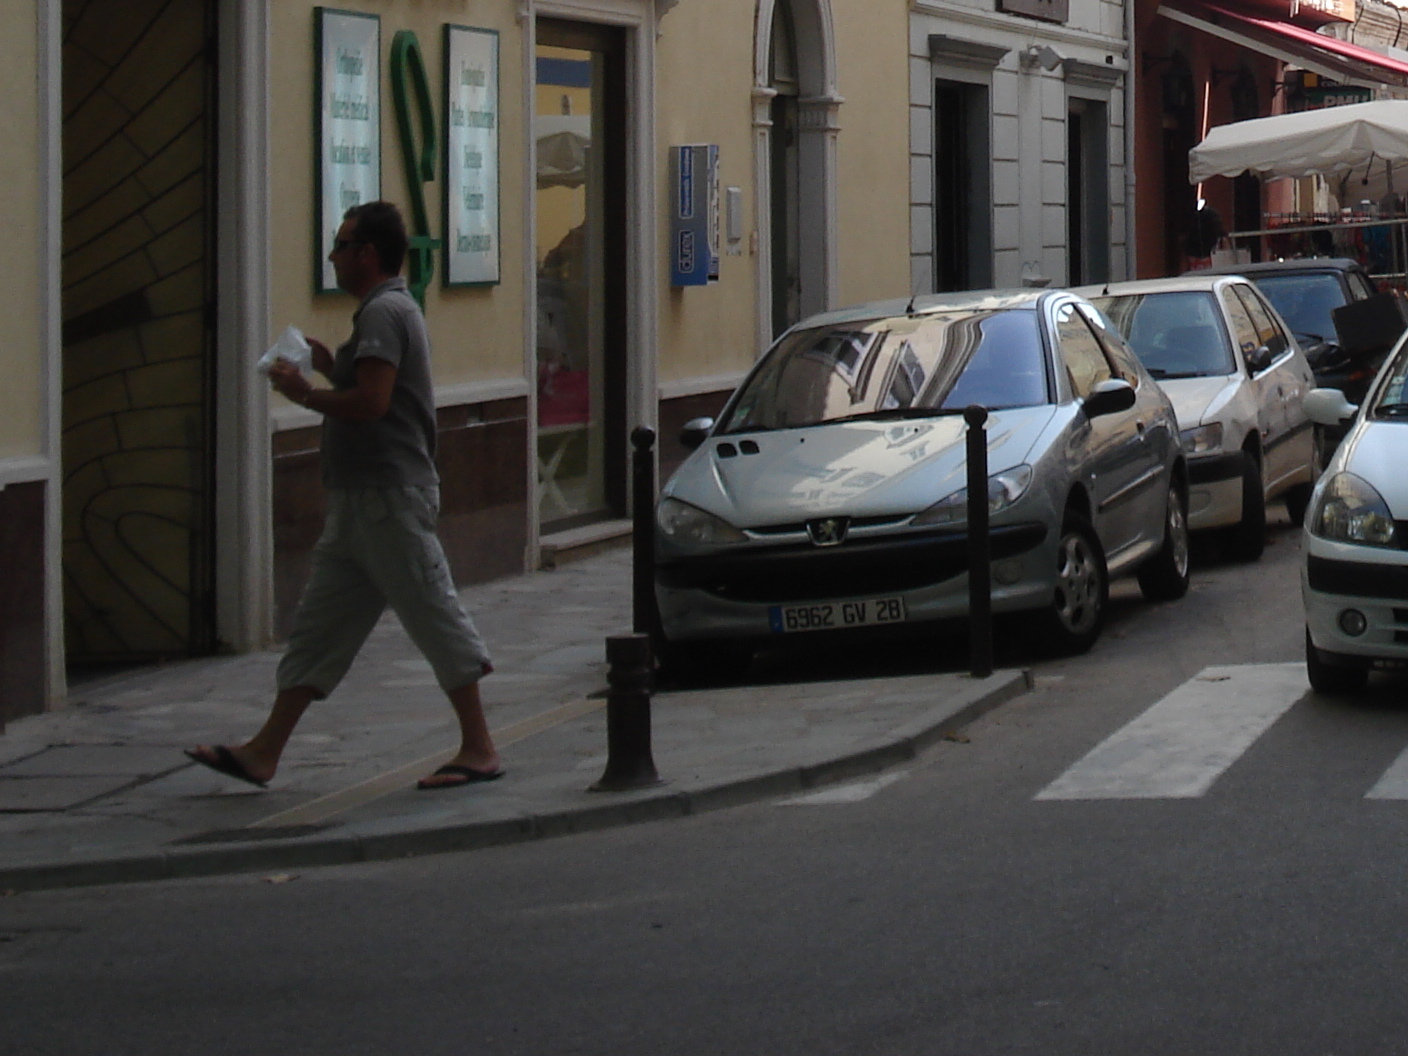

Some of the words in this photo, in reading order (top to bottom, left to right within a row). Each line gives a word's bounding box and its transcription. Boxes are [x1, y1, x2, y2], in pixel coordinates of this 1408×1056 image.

[785, 605, 834, 629] 6962
[843, 602, 866, 624] GV
[876, 599, 900, 621] 2B
